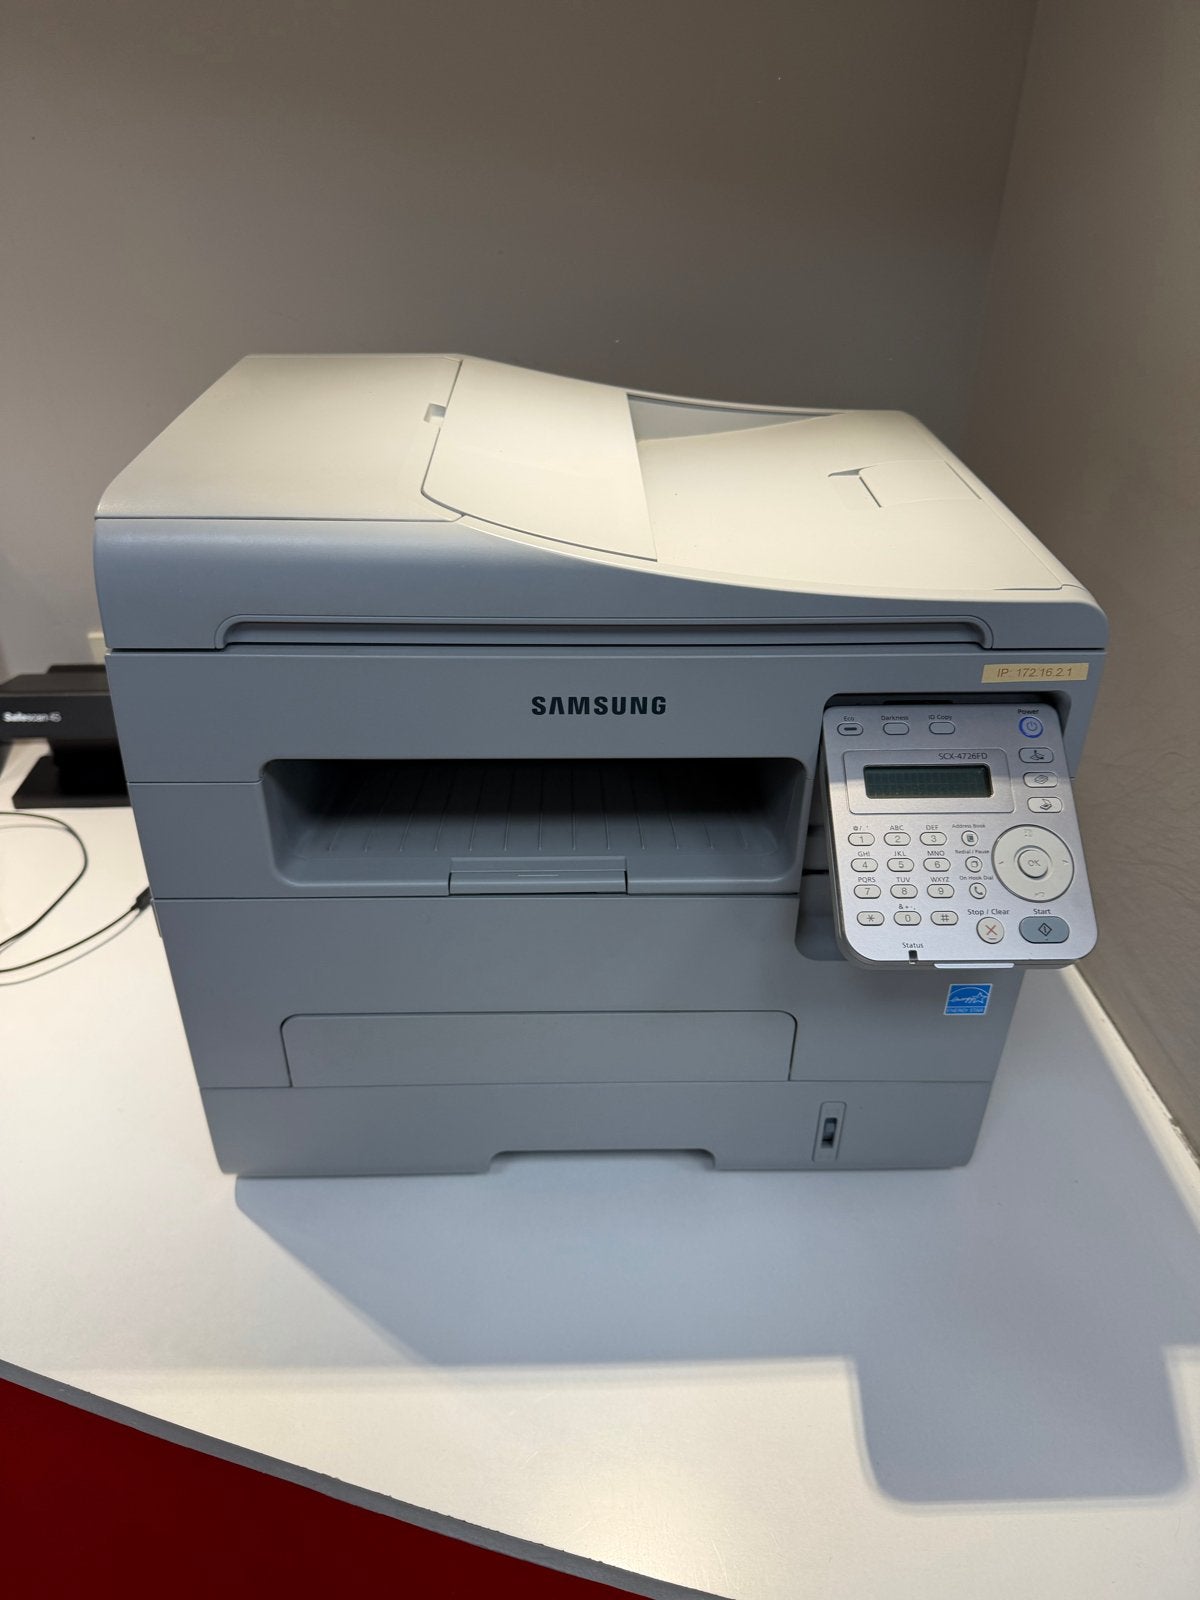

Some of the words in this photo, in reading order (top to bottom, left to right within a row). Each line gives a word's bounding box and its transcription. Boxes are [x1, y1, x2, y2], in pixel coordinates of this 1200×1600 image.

[531, 696, 667, 715] SAMSUNG
[938, 752, 988, 761] SCX-4726FD
[967, 908, 985, 916] Stop
